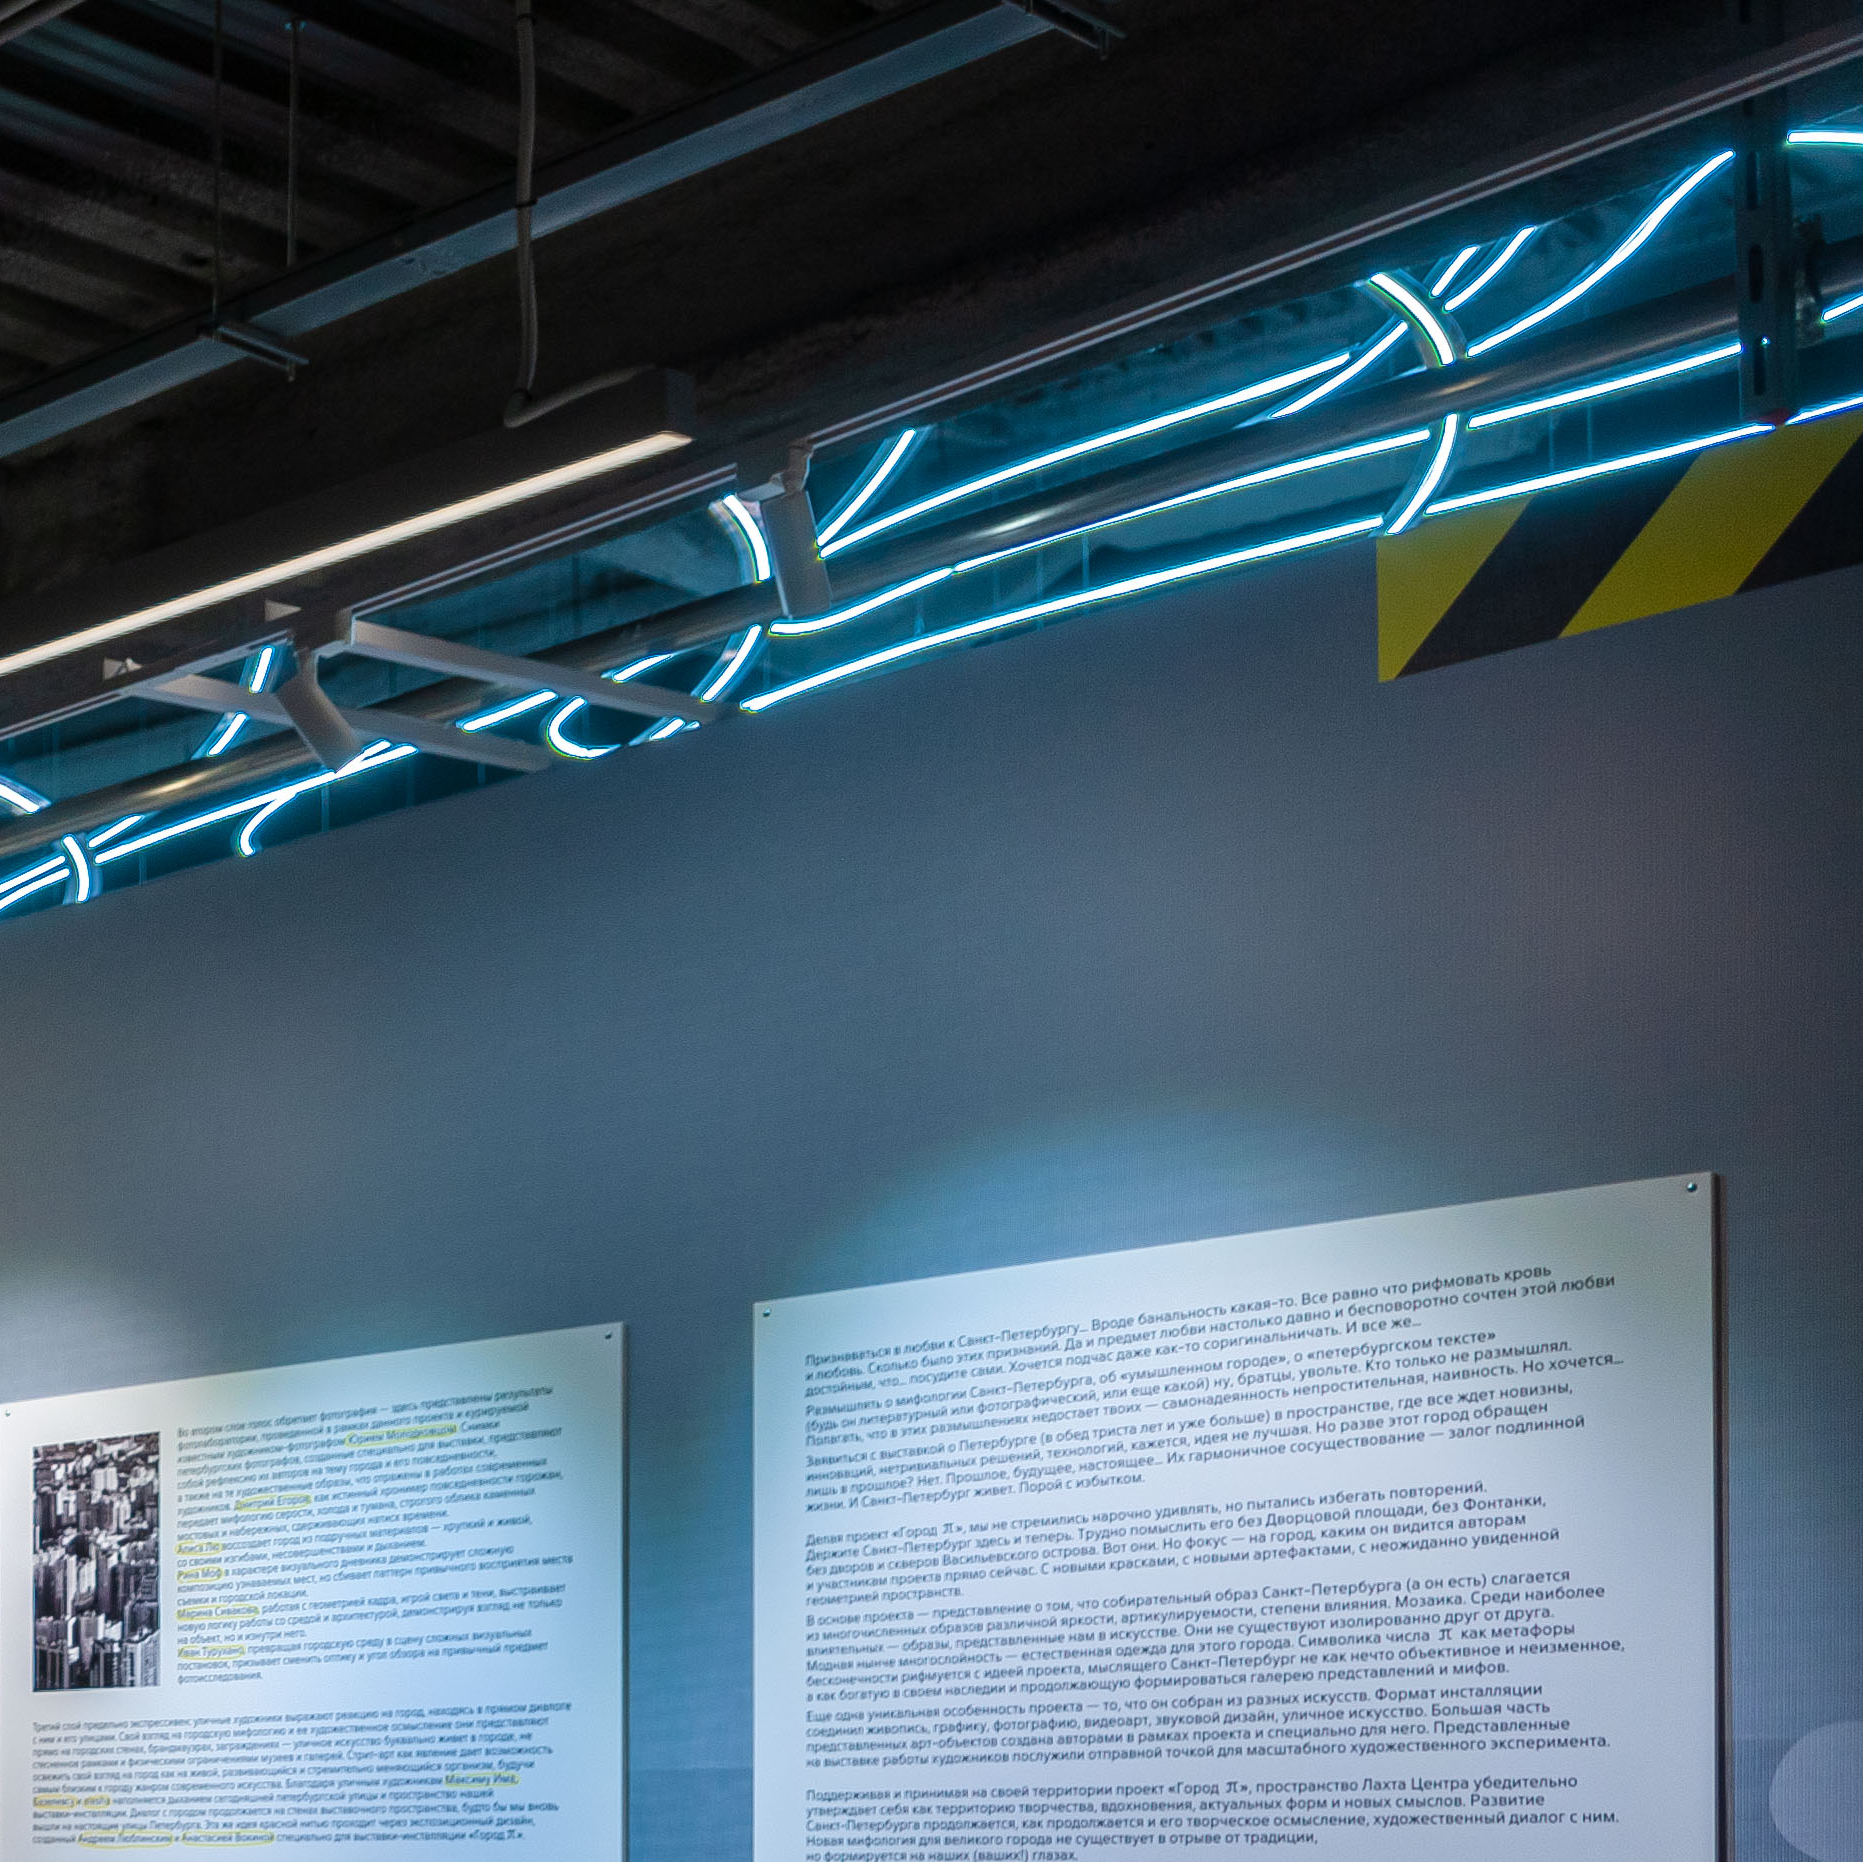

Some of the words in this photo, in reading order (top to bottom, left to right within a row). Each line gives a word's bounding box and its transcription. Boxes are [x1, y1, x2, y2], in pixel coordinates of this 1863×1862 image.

[805, 1789, 891, 1804] Поддерживая
[892, 1789, 901, 1800] и
[903, 1788, 969, 1803] принимая
[970, 1788, 987, 1799] на
[990, 1784, 1029, 1799] своей
[1032, 1785, 1113, 1800] территории
[1115, 1784, 1163, 1799] проект
[1168, 1781, 1219, 1797] «Город
[1255, 1780, 1358, 1796] пространство
[1361, 1777, 1406, 1792] Лахта
[1410, 1776, 1469, 1794] Центра
[1473, 1774, 1577, 1793] убедительно
[806, 1805, 876, 1820] утверждает
[878, 1802, 909, 1816] себя
[911, 1804, 933, 1816] как
[935, 1803, 1015, 1817] территорию
[1018, 1802, 1097, 1816] творчества,
[1100, 1800, 1195, 1815] вдохновения,
[1198, 1798, 1282, 1814] актуальных
[1285, 1795, 1327, 1813] форм
[1331, 1797, 1340, 1809] и
[1343, 1796, 1391, 1809] новых
[1395, 1795, 1465, 1808] смыслов.
[1470, 1792, 1545, 1807] Развитие
[805, 1818, 920, 1834] Санкт-Петербурга
[922, 1819, 1018, 1833] продолжается,
[1021, 1818, 1043, 1830] как
[1046, 1817, 1144, 1832] продолжается
[1147, 1817, 1156, 1828] и
[1159, 1816, 1183, 1828] его
[1186, 1815, 1270, 1830] творческое
[1273, 1814, 1369, 1829] осмысление,
[1373, 1809, 1505, 1828] художественный
[1509, 1811, 1563, 1827] диалог
[1569, 1811, 1577, 1824] с
[1582, 1811, 1619, 1823] ним.
[805, 1835, 844, 1847] Новая
[846, 1834, 916, 1849] мифология
[918, 1836, 941, 1848] для
[943, 1835, 1003, 1846] великого
[1006, 1835, 1052, 1847] города
[1055, 1834, 1072, 1845] не
[1075, 1834, 1154, 1847] существует
[1157, 1833, 1166, 1844] в
[1169, 1833, 1221, 1846] отрыве
[1225, 1833, 1239, 1843] от
[1244, 1832, 1318, 1846] традиции,
